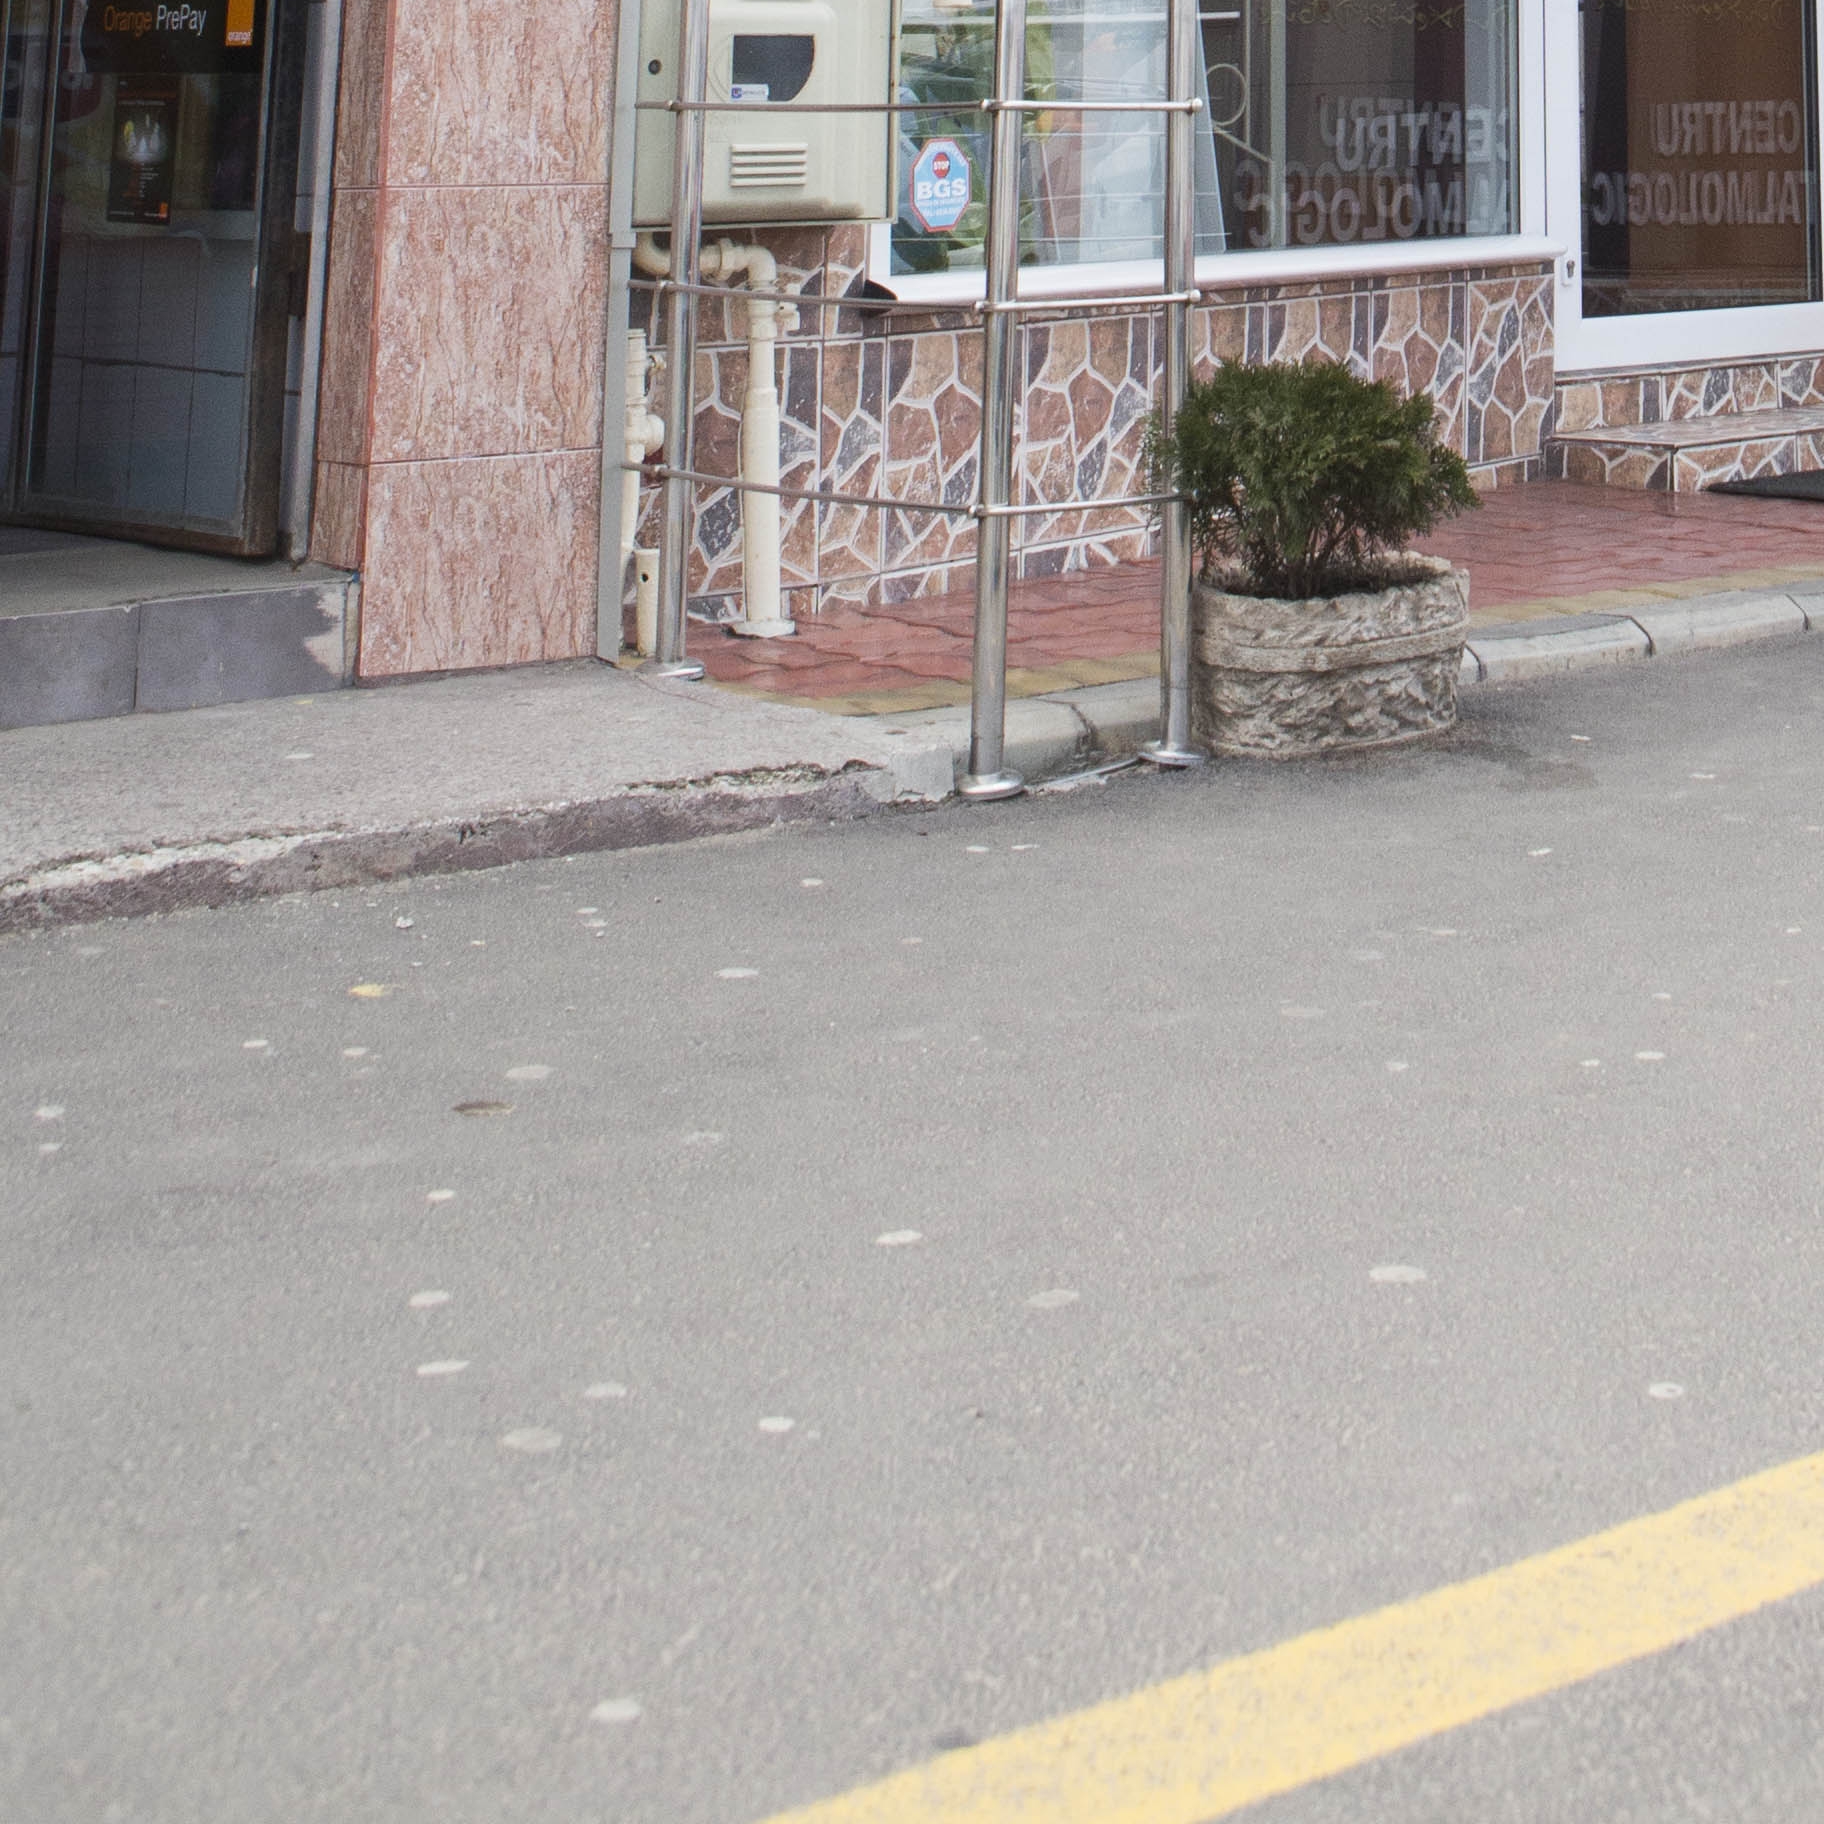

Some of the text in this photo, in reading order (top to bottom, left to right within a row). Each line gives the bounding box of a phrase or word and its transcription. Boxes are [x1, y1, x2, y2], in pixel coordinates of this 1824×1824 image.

[104, 3, 208, 38] Orange PrePay
[917, 178, 967, 201] BGS
